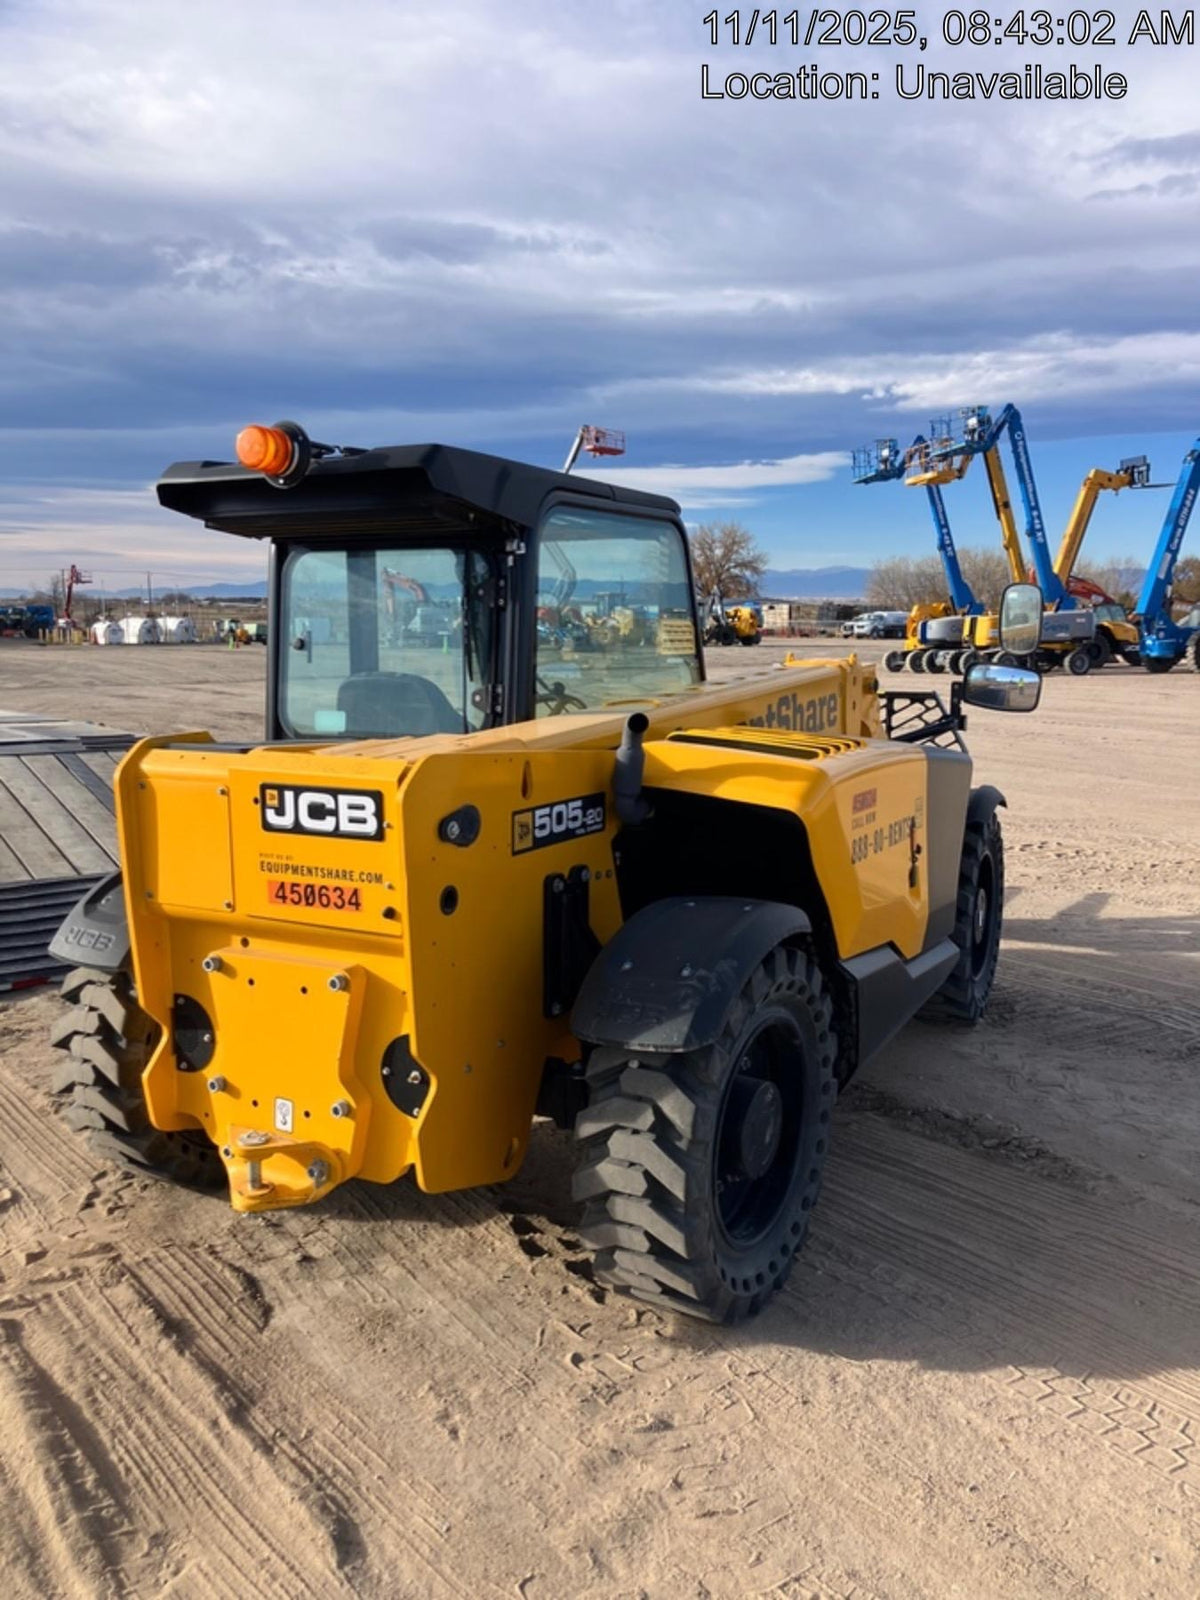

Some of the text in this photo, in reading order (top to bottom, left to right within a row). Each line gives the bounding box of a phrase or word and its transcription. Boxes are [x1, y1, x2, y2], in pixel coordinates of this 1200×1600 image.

[265, 790, 378, 837] JCB
[260, 860, 384, 884] EQUIPMENTSHARE.COM
[275, 881, 362, 911] 450634
